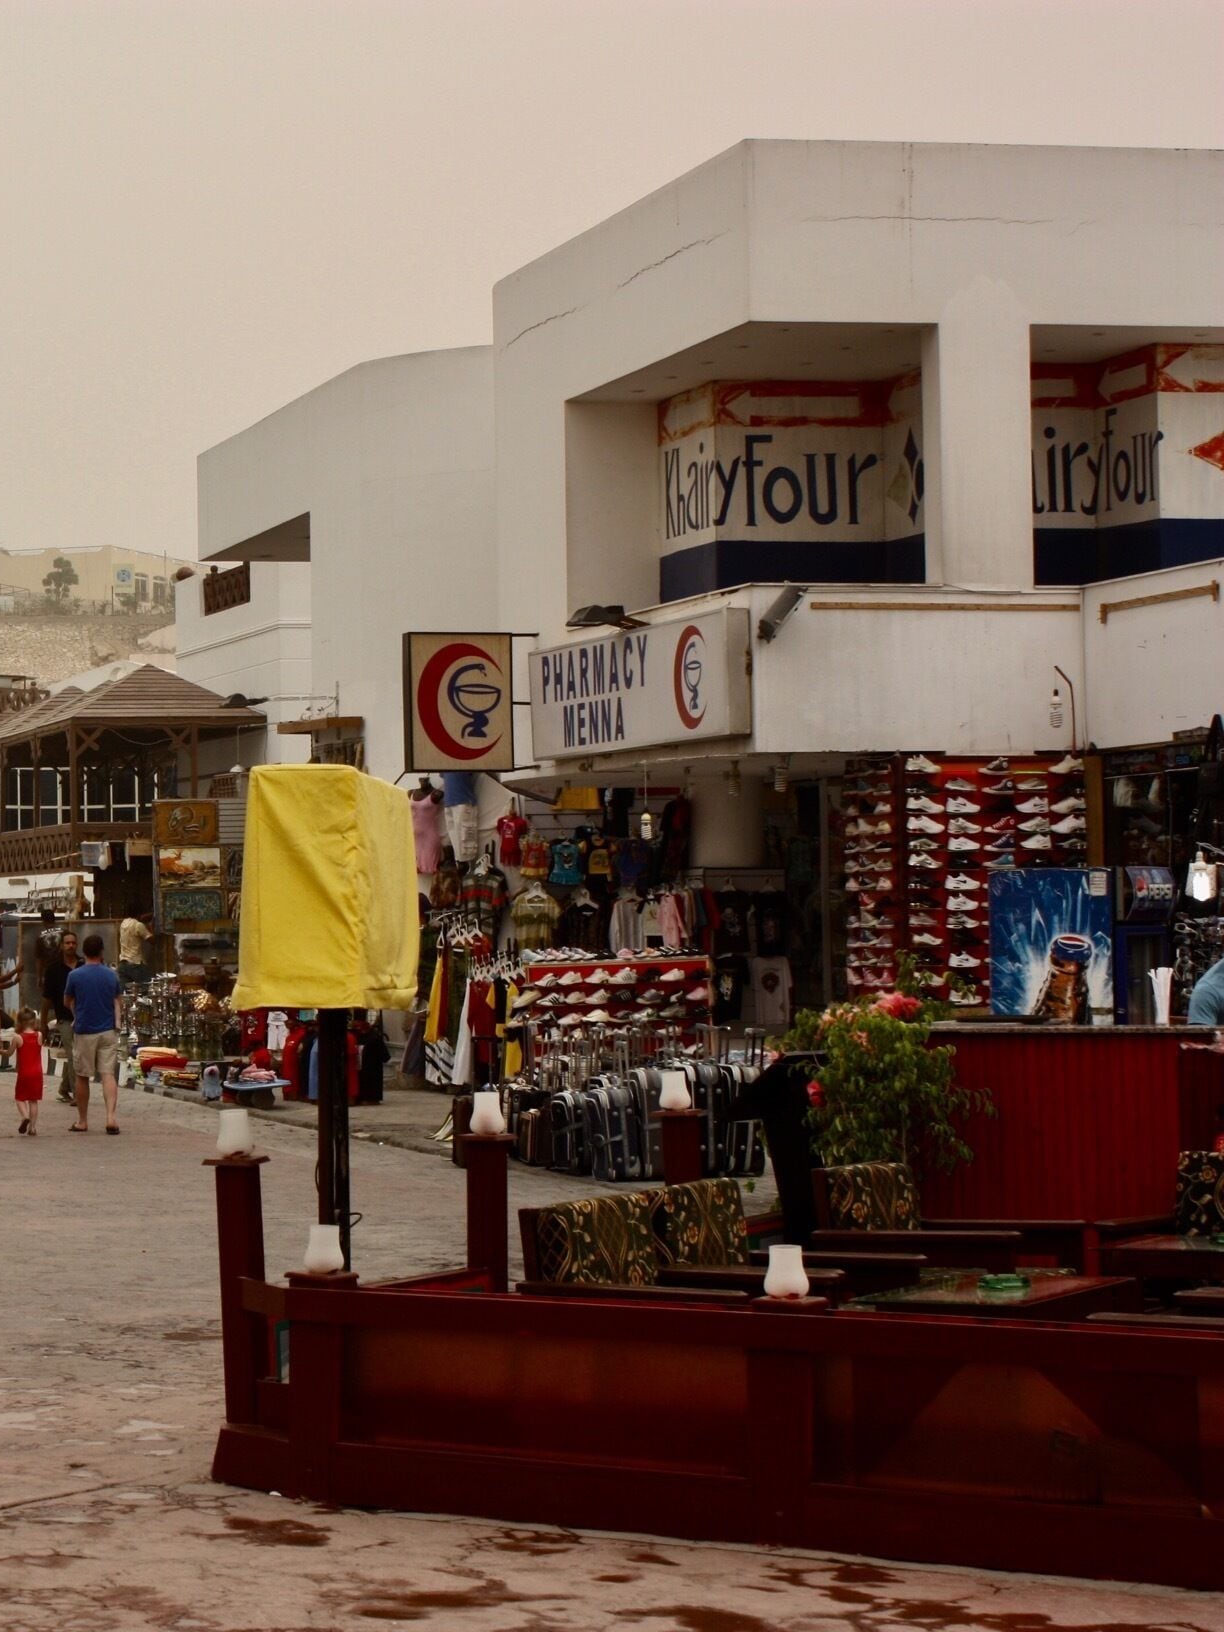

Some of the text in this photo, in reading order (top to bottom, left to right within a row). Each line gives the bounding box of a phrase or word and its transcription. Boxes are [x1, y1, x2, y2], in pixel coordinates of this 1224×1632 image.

[541, 633, 648, 705] PHARMACY
[563, 696, 625, 749] MENNA
[1148, 883, 1174, 900] PEPSI
